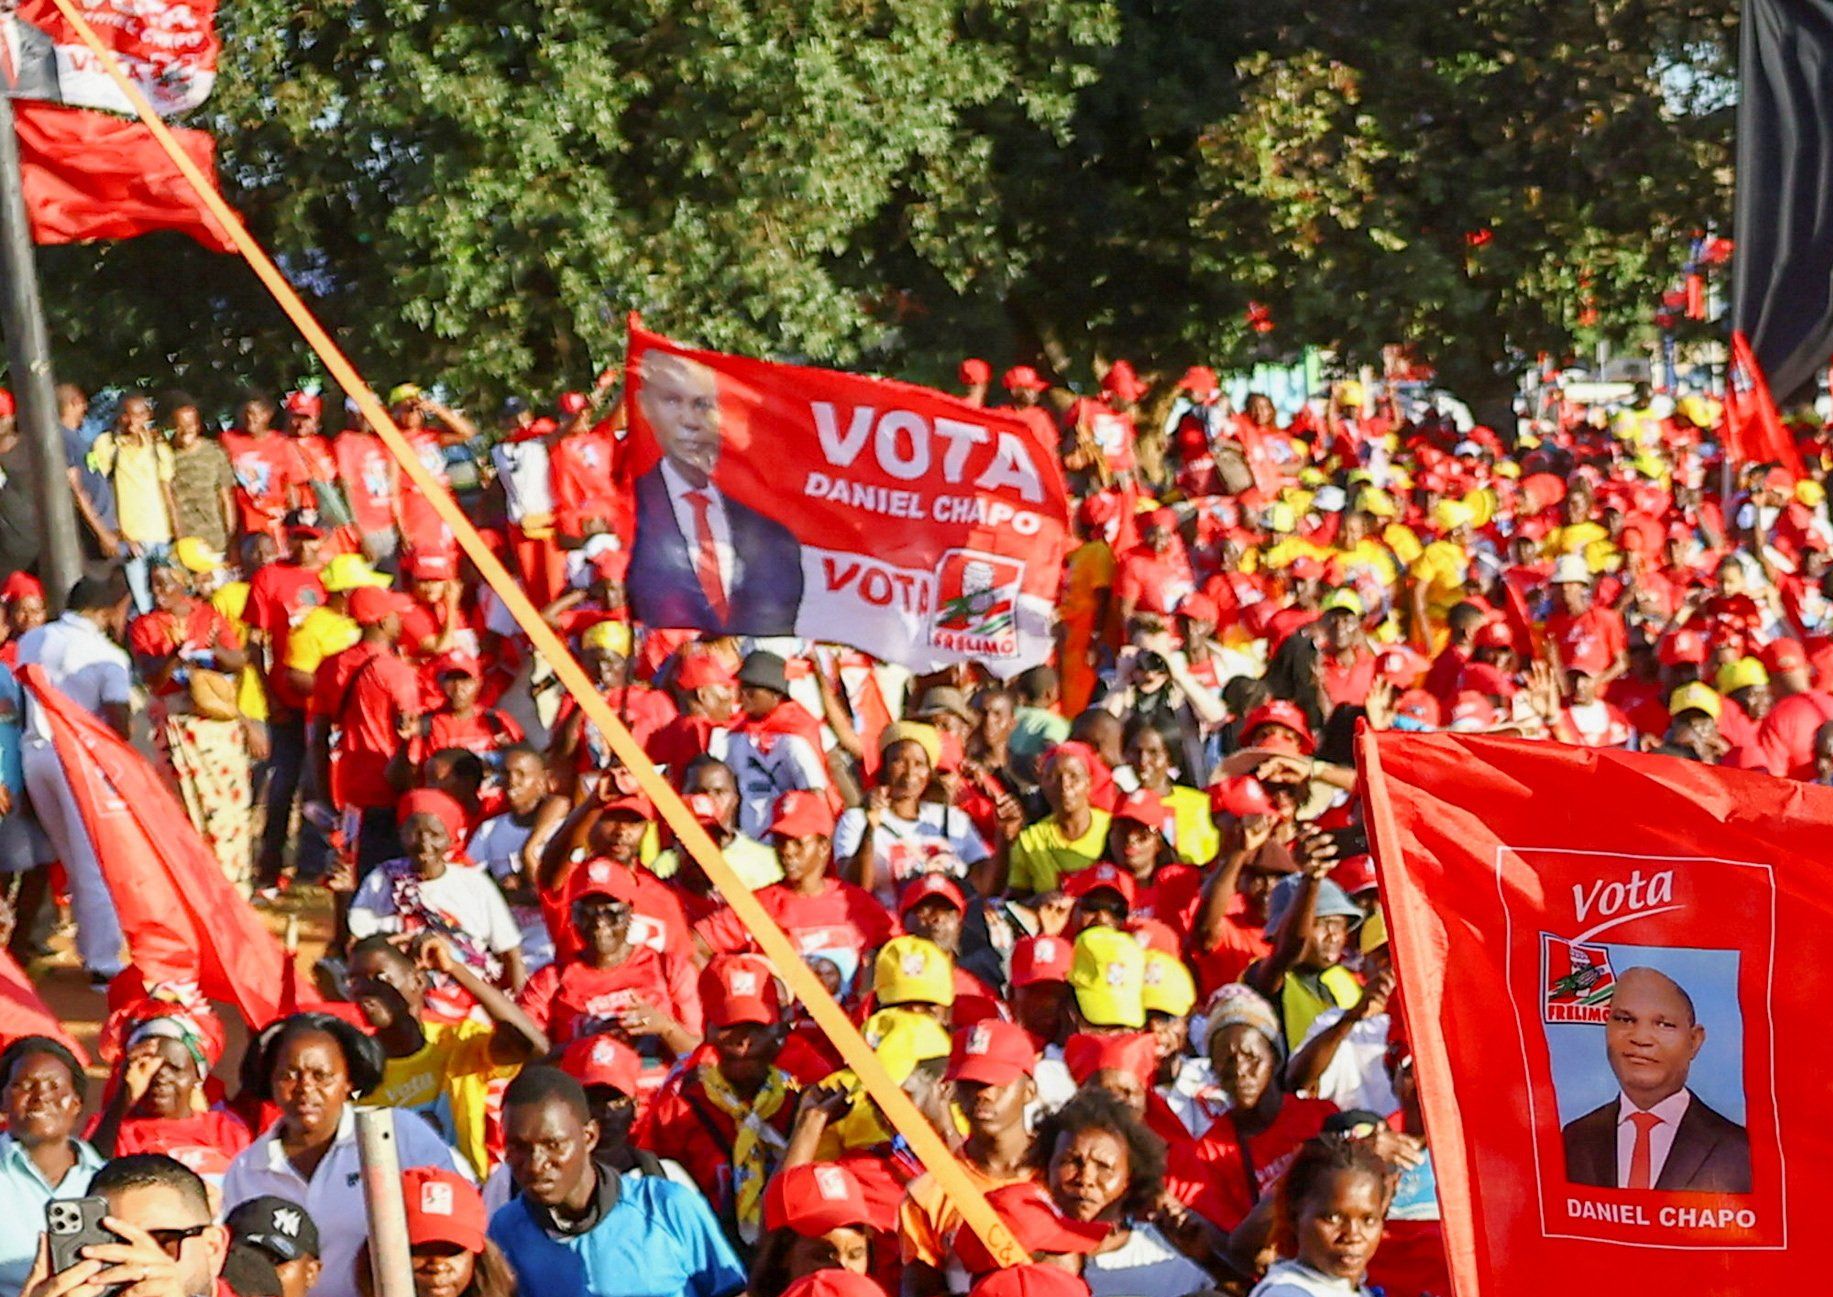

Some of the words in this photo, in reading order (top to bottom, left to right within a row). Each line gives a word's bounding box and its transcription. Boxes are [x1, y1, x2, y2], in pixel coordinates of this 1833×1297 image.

[810, 402, 1043, 502] VOTA
[805, 472, 925, 519] DANIEL
[932, 489, 1041, 535] CHAPO
[821, 556, 928, 617] VOTA
[933, 632, 1014, 656] FRELIMO
[1573, 870, 1674, 922] Vota
[272, 1207, 302, 1238] NY
[1567, 1198, 1650, 1226] DANIEL
[1659, 1205, 1756, 1229] CHAPO
